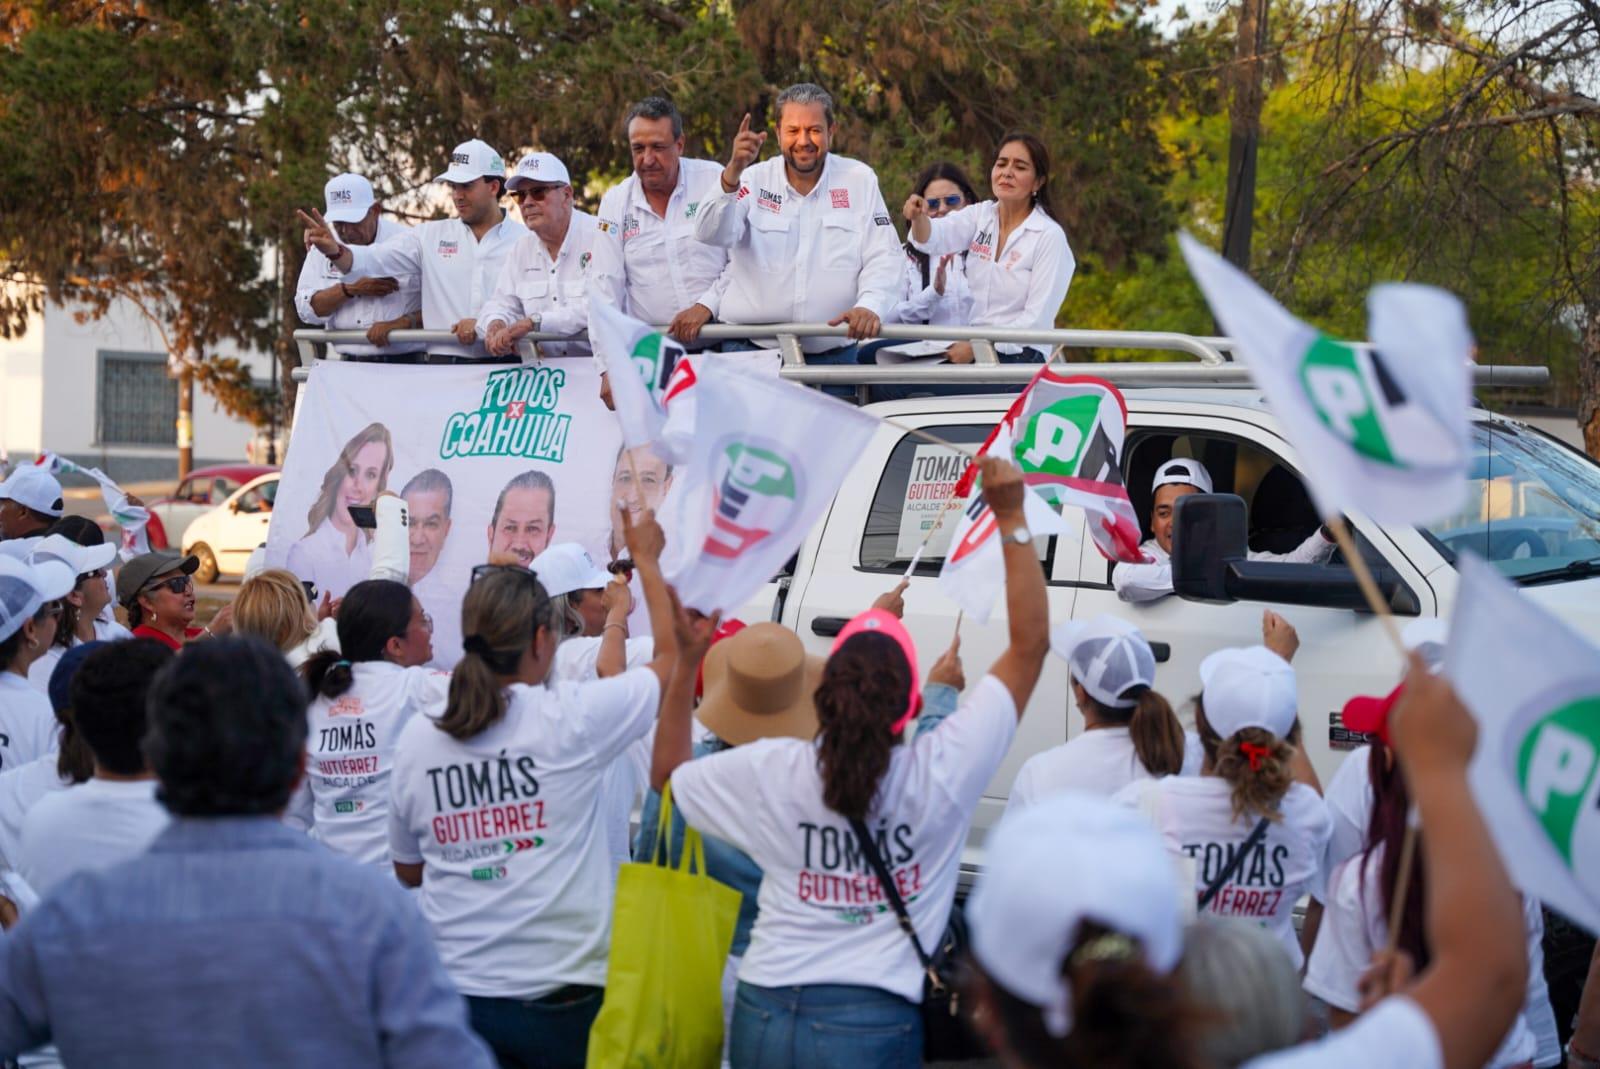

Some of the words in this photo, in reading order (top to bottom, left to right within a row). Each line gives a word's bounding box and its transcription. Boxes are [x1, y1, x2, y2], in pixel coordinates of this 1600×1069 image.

[482, 368, 565, 411] TODOS
[440, 411, 571, 462] COAHUILA
[319, 718, 376, 752] TOMÁS
[427, 749, 540, 812] TOMÁS
[432, 800, 547, 845] GUTIÉRREZ
[798, 863, 922, 905] GUTIÉREZ
